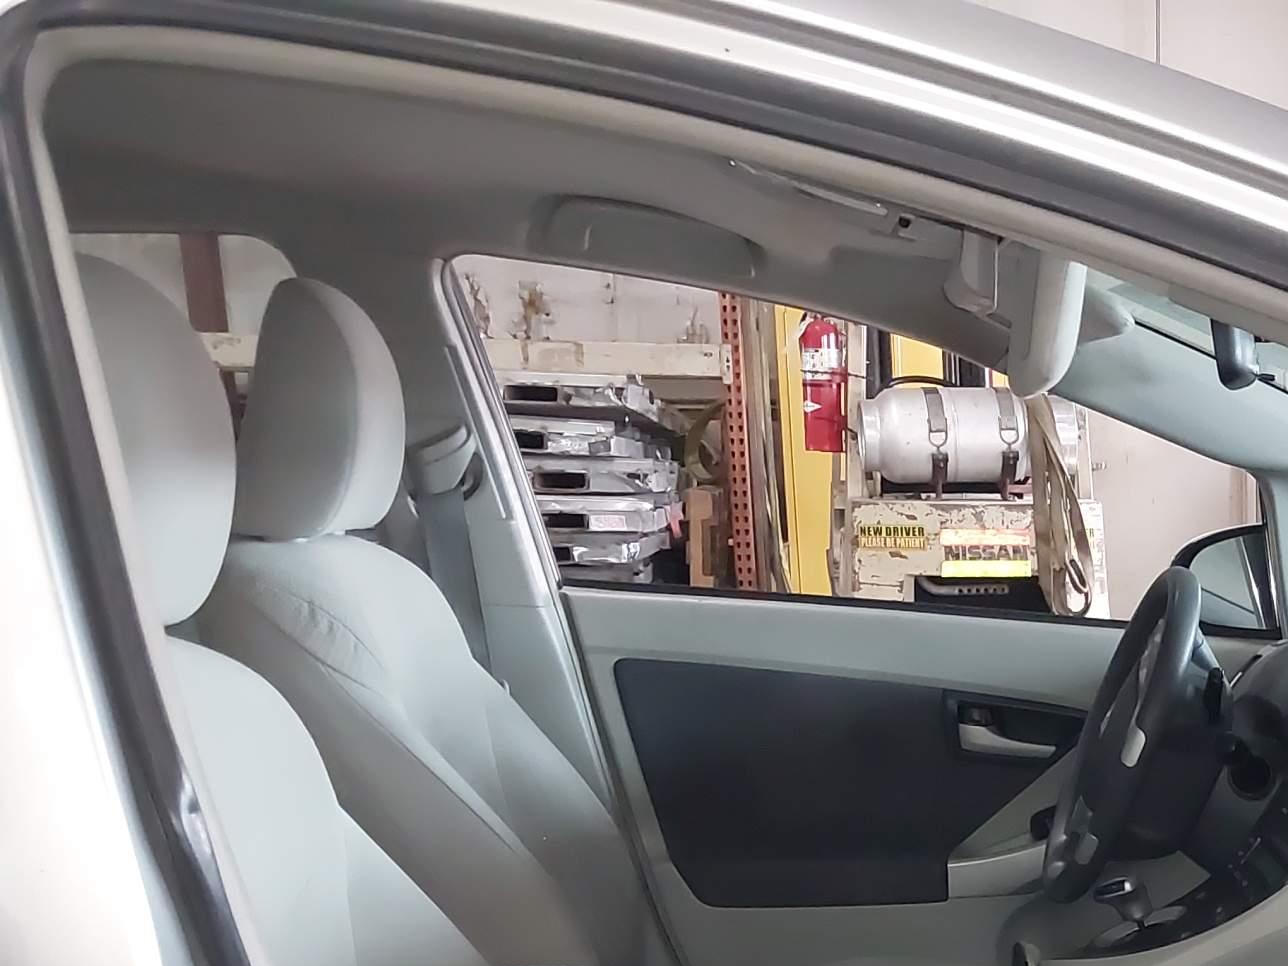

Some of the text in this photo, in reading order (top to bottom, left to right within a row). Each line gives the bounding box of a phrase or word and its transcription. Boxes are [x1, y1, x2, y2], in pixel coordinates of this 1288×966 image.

[860, 526, 925, 537] NEW DRIVER
[861, 537, 886, 549] PLEASE
[896, 537, 925, 549] PATIENT
[944, 545, 1029, 561] NISSAN
